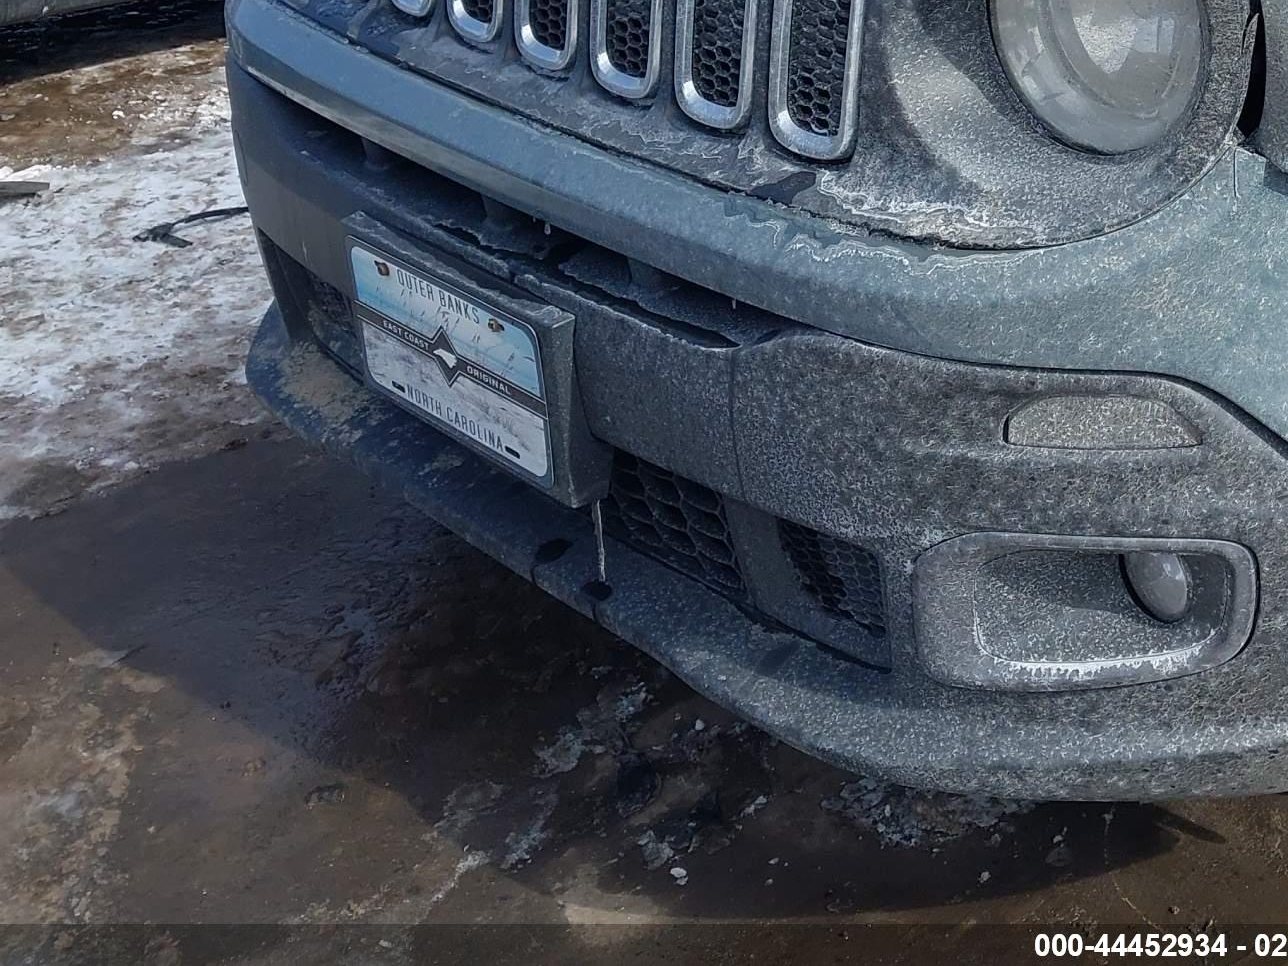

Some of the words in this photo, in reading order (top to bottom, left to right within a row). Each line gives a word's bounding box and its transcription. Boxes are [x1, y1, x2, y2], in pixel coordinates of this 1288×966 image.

[396, 269, 434, 302] OUTER
[439, 291, 480, 325] BANKS
[382, 319, 402, 336] EAST
[404, 331, 429, 350] COAST
[466, 365, 511, 395] ORIGINAL
[407, 385, 442, 414] NORTH
[446, 406, 504, 452] CAROLINA
